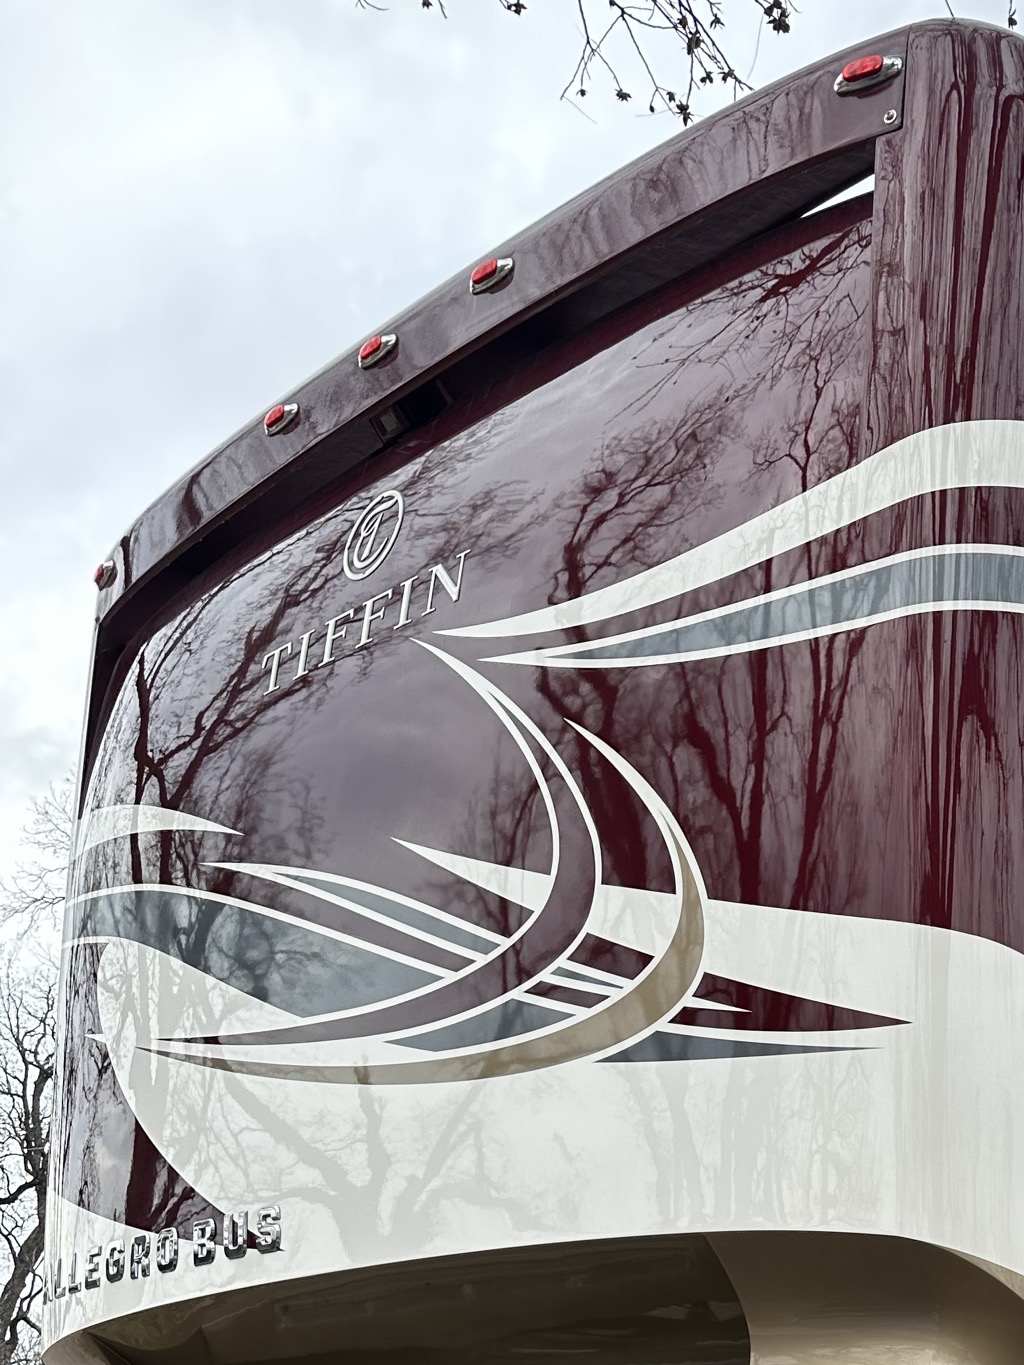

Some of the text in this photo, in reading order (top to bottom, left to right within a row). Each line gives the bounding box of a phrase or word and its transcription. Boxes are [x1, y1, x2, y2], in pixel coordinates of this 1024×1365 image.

[261, 549, 471, 696] TIFFIN
[43, 1205, 281, 1305] ALLEGRO BUS
